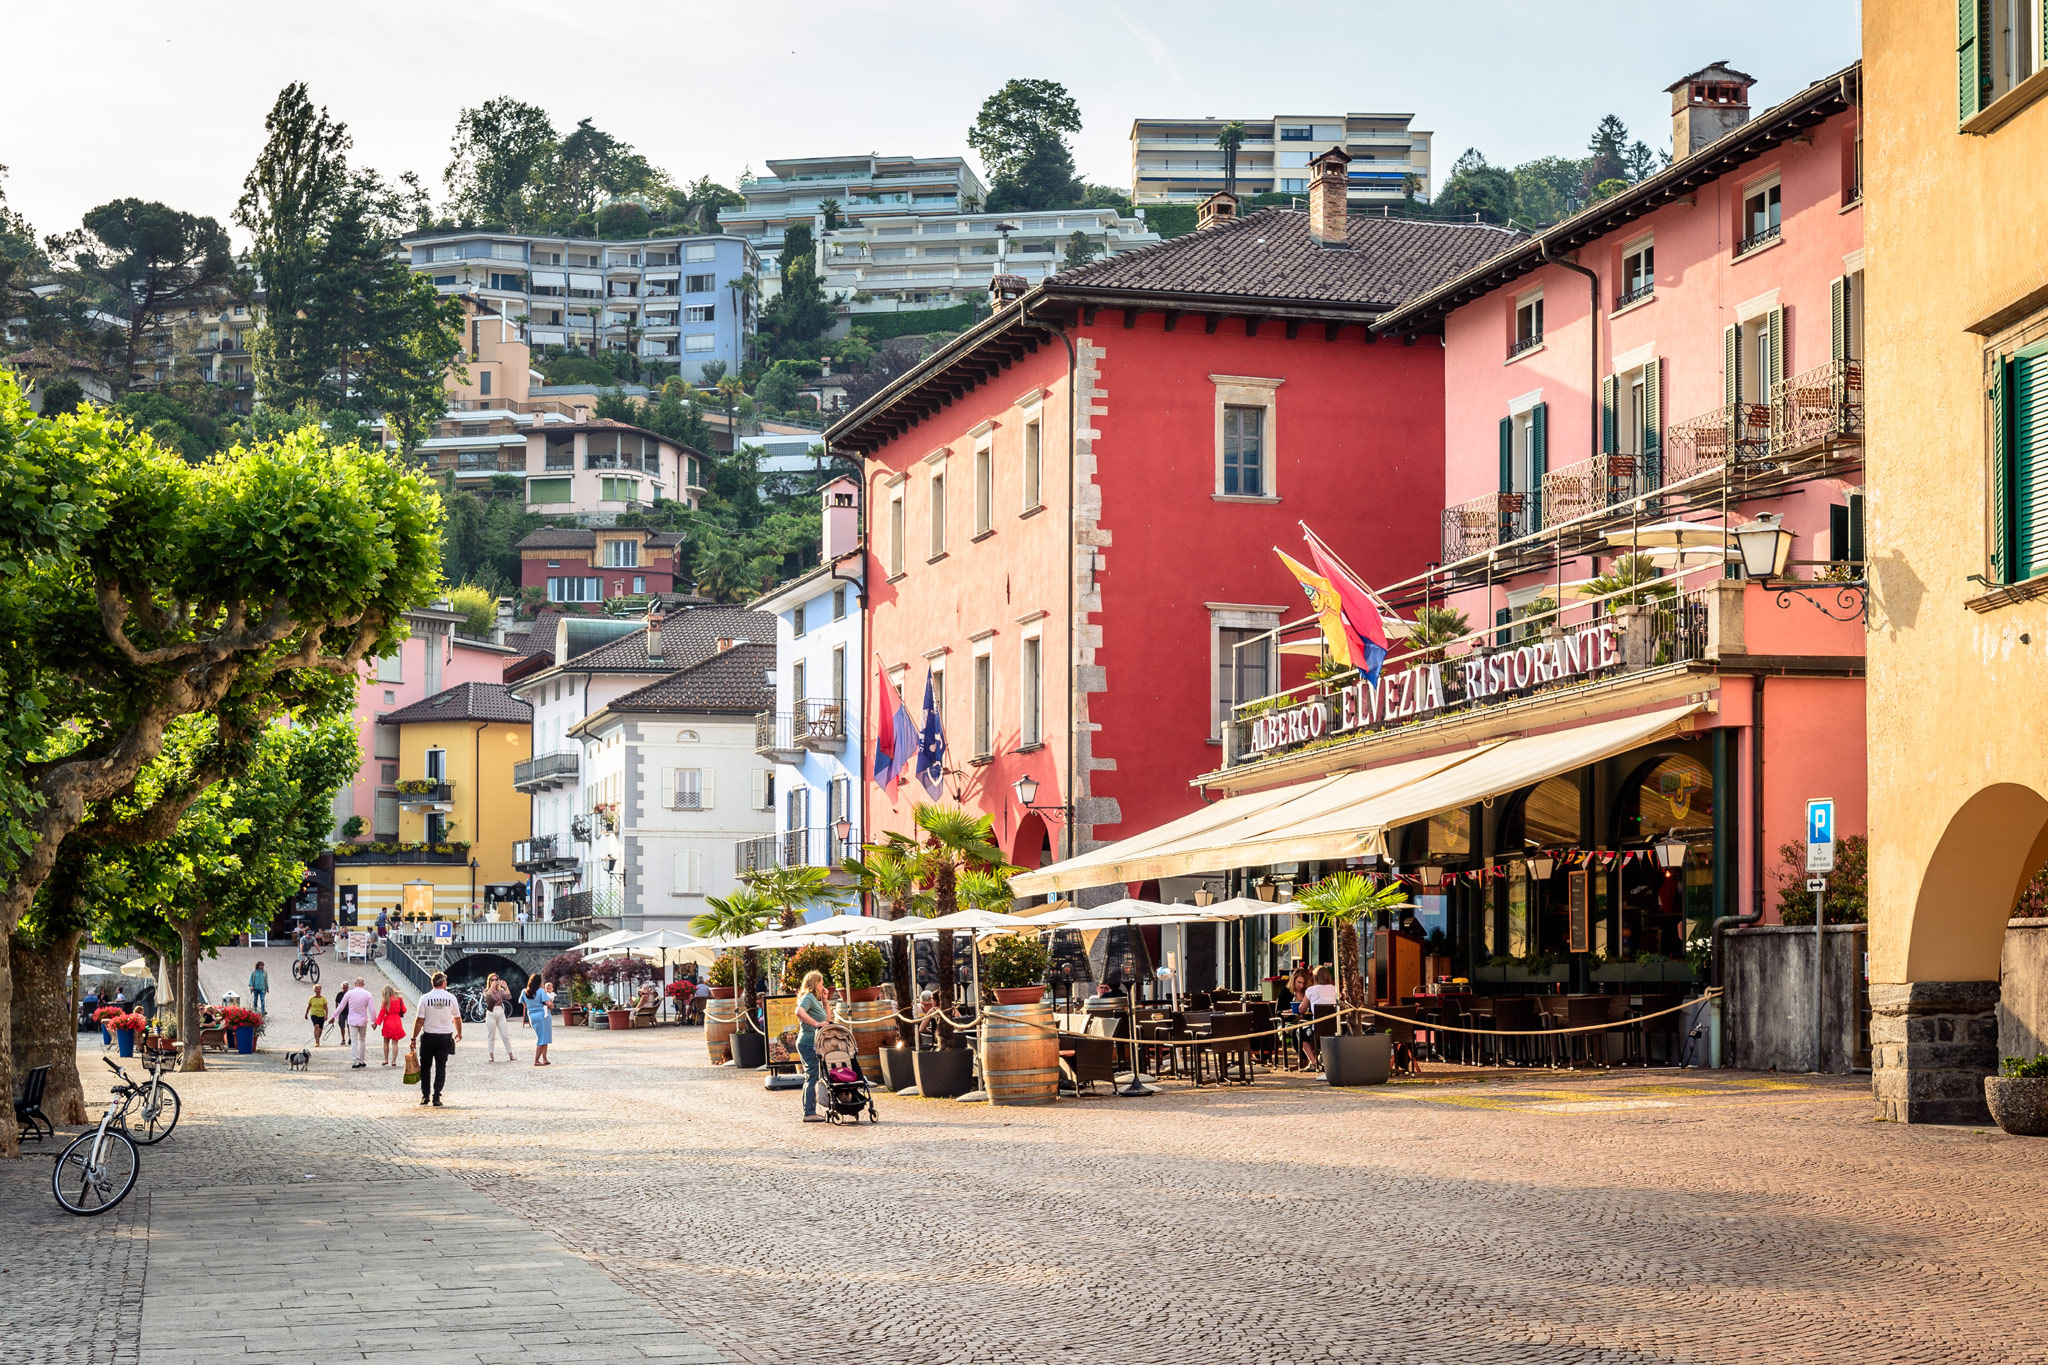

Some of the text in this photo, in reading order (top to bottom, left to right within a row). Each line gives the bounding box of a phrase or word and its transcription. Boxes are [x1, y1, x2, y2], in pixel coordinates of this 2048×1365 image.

[1251, 623, 1618, 752] ALBERGO ELVEZIA RISTORANTE
[1815, 809, 1826, 838] P
[439, 924, 448, 937] P
